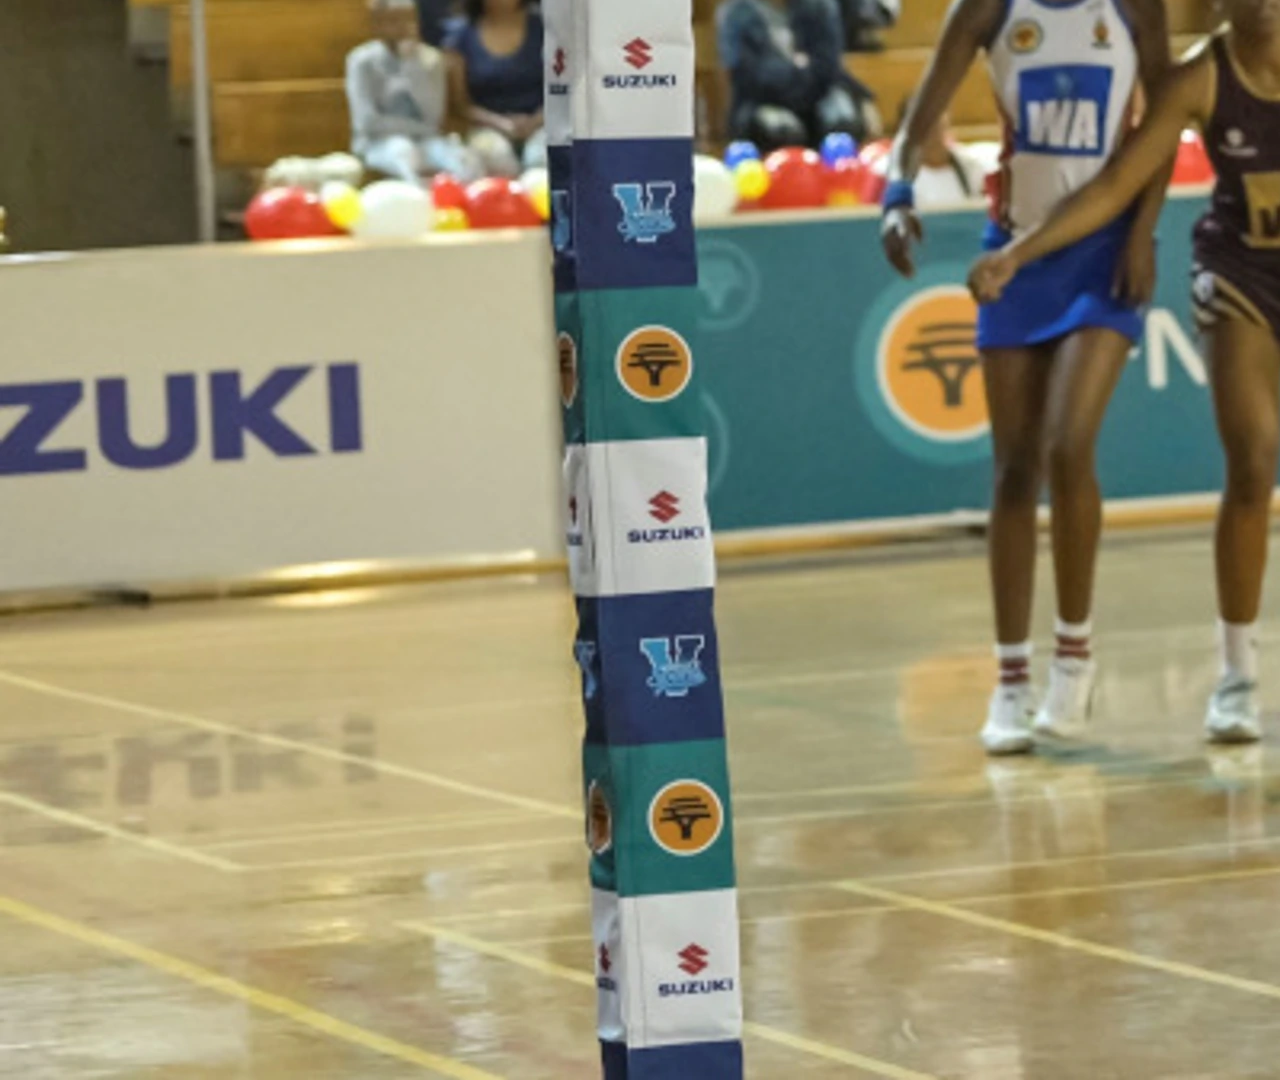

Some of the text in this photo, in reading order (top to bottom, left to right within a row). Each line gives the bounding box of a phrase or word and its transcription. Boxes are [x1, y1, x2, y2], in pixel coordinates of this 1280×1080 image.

[602, 74, 676, 89] SUZUKI
[1026, 99, 1099, 150] WA
[627, 526, 705, 543] SUZUKI
[658, 977, 734, 997] SUZUKI
